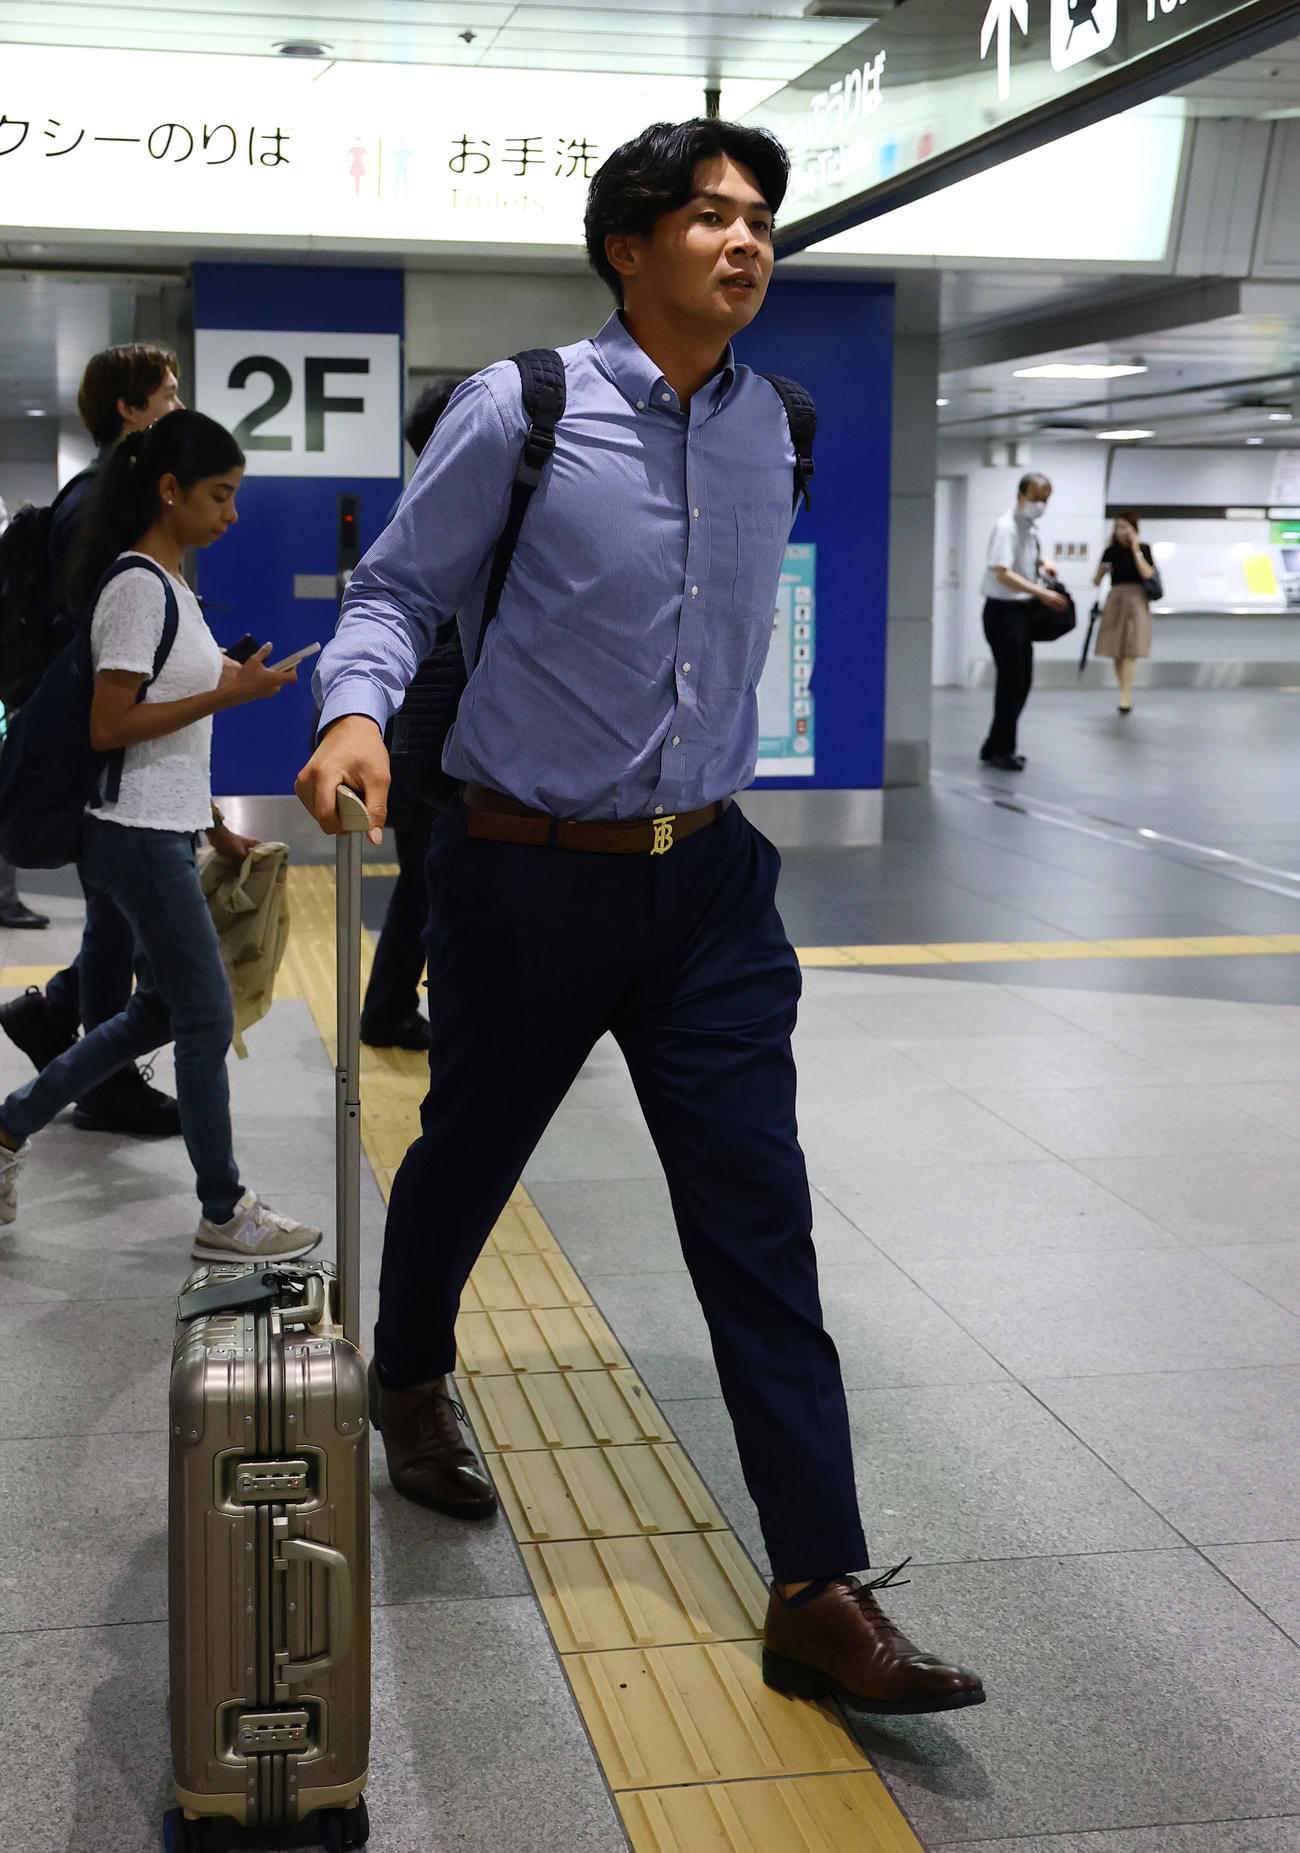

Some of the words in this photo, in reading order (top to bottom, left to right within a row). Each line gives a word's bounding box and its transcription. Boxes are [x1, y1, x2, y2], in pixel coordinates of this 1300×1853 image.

[0, 115, 293, 167] クシーのりば
[228, 355, 369, 452] 2F
